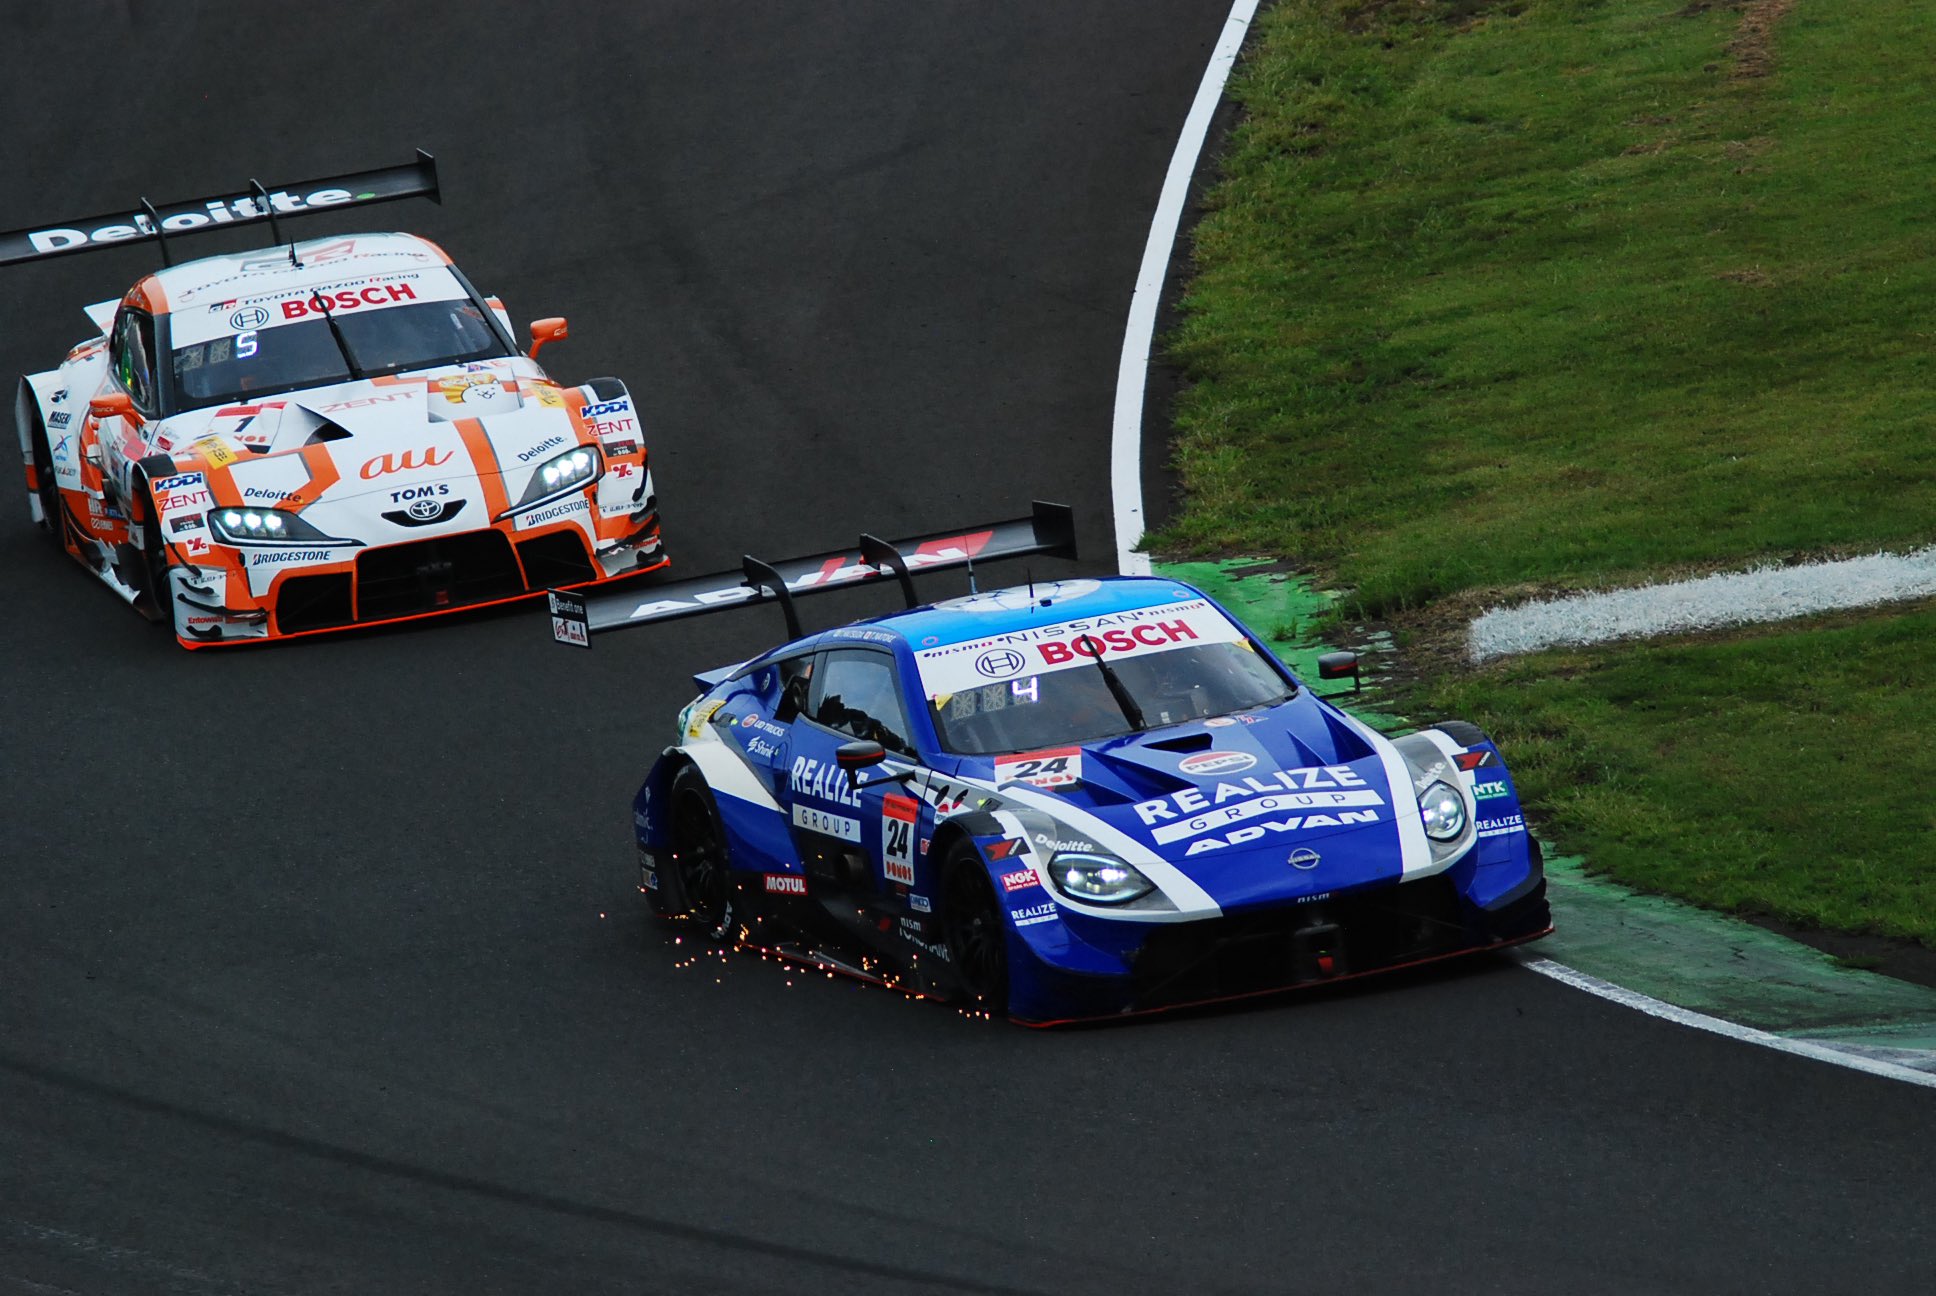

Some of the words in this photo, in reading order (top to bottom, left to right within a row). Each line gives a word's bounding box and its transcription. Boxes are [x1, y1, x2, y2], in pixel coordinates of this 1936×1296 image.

[243, 288, 305, 304] TOYOTA
[368, 272, 420, 283] Racing
[281, 283, 417, 320] BOSCH
[319, 390, 418, 413] ZENT
[587, 418, 634, 437] ZENT
[359, 446, 454, 480] au
[158, 490, 209, 512] ZENT
[390, 483, 449, 504] TOM'S
[525, 499, 590, 527] BRIDGESTONE
[252, 550, 331, 567] BRIDGESTONE
[1006, 612, 1140, 644] NISSAN
[1037, 618, 1199, 666] BOSCH
[1011, 676, 1039, 703] 4
[1014, 757, 1069, 779] 24
[791, 755, 869, 809] REALIZE
[1472, 781, 1506, 796] NTK
[1131, 765, 1367, 826] REALIZE
[801, 809, 851, 836] GROUP
[1189, 794, 1346, 831] GROUP
[1475, 814, 1523, 830] REALIZE
[886, 818, 910, 860] 24
[1185, 809, 1379, 857] ADVAN
[766, 875, 806, 892] MOTUL
[1003, 870, 1037, 887] NGK
[1297, 889, 1338, 904] nism
[1010, 902, 1057, 920] REALIZE
[900, 916, 924, 932] nism
